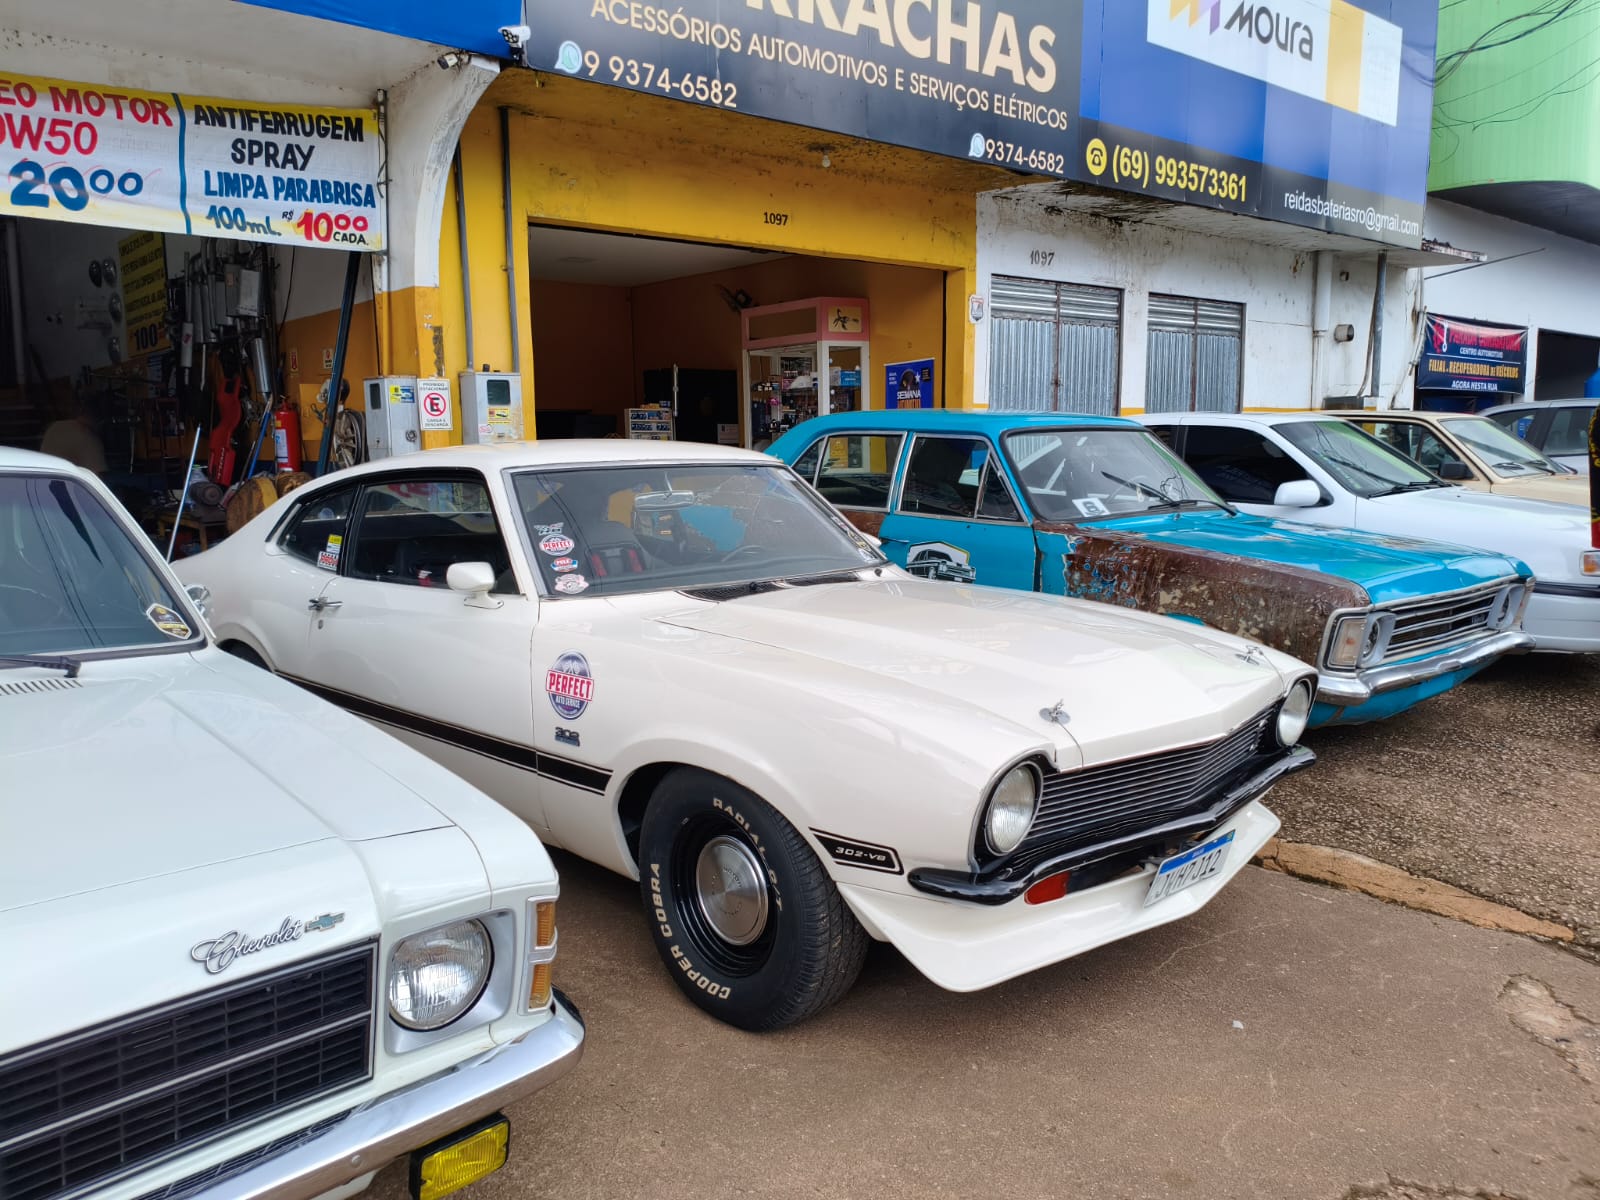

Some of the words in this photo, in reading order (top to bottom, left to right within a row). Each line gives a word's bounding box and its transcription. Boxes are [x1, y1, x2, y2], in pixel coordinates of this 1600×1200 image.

[584, 50, 600, 77] 9
[608, 56, 737, 108] 9374-6582
[591, 0, 742, 53] ACESSÓRIOS
[748, 33, 888, 88] AUTOMOTIVOS
[895, 68, 904, 91] E
[910, 72, 989, 111] SERVIÇOS
[993, 92, 1068, 130] ELÉTRICOS
[49, 86, 174, 127] MOTOR
[194, 104, 364, 142] ANTIFERRUGEM
[0, 112, 98, 156] W50
[231, 138, 315, 171] SPRAY
[985, 138, 1064, 174] 9374-6582
[1112, 144, 1149, 188] (69)
[1155, 155, 1247, 202] 993573361
[204, 170, 269, 200] LIMPA
[273, 175, 376, 208] PARABRISA
[763, 212, 788, 226] 1097
[1284, 190, 1419, 236] reidasbateriasro@gmail.com
[1030, 249, 1055, 265] 1097
[1451, 380, 1470, 389] AGORA
[1470, 381, 1487, 390] NESTA
[549, 672, 591, 699] PERFECT
[712, 798, 765, 855] RADIAL
[835, 846, 887, 862] 302-V8
[650, 863, 672, 938] COBRA
[190, 914, 303, 975] Chevrolet
[670, 944, 732, 1000] COOPER
